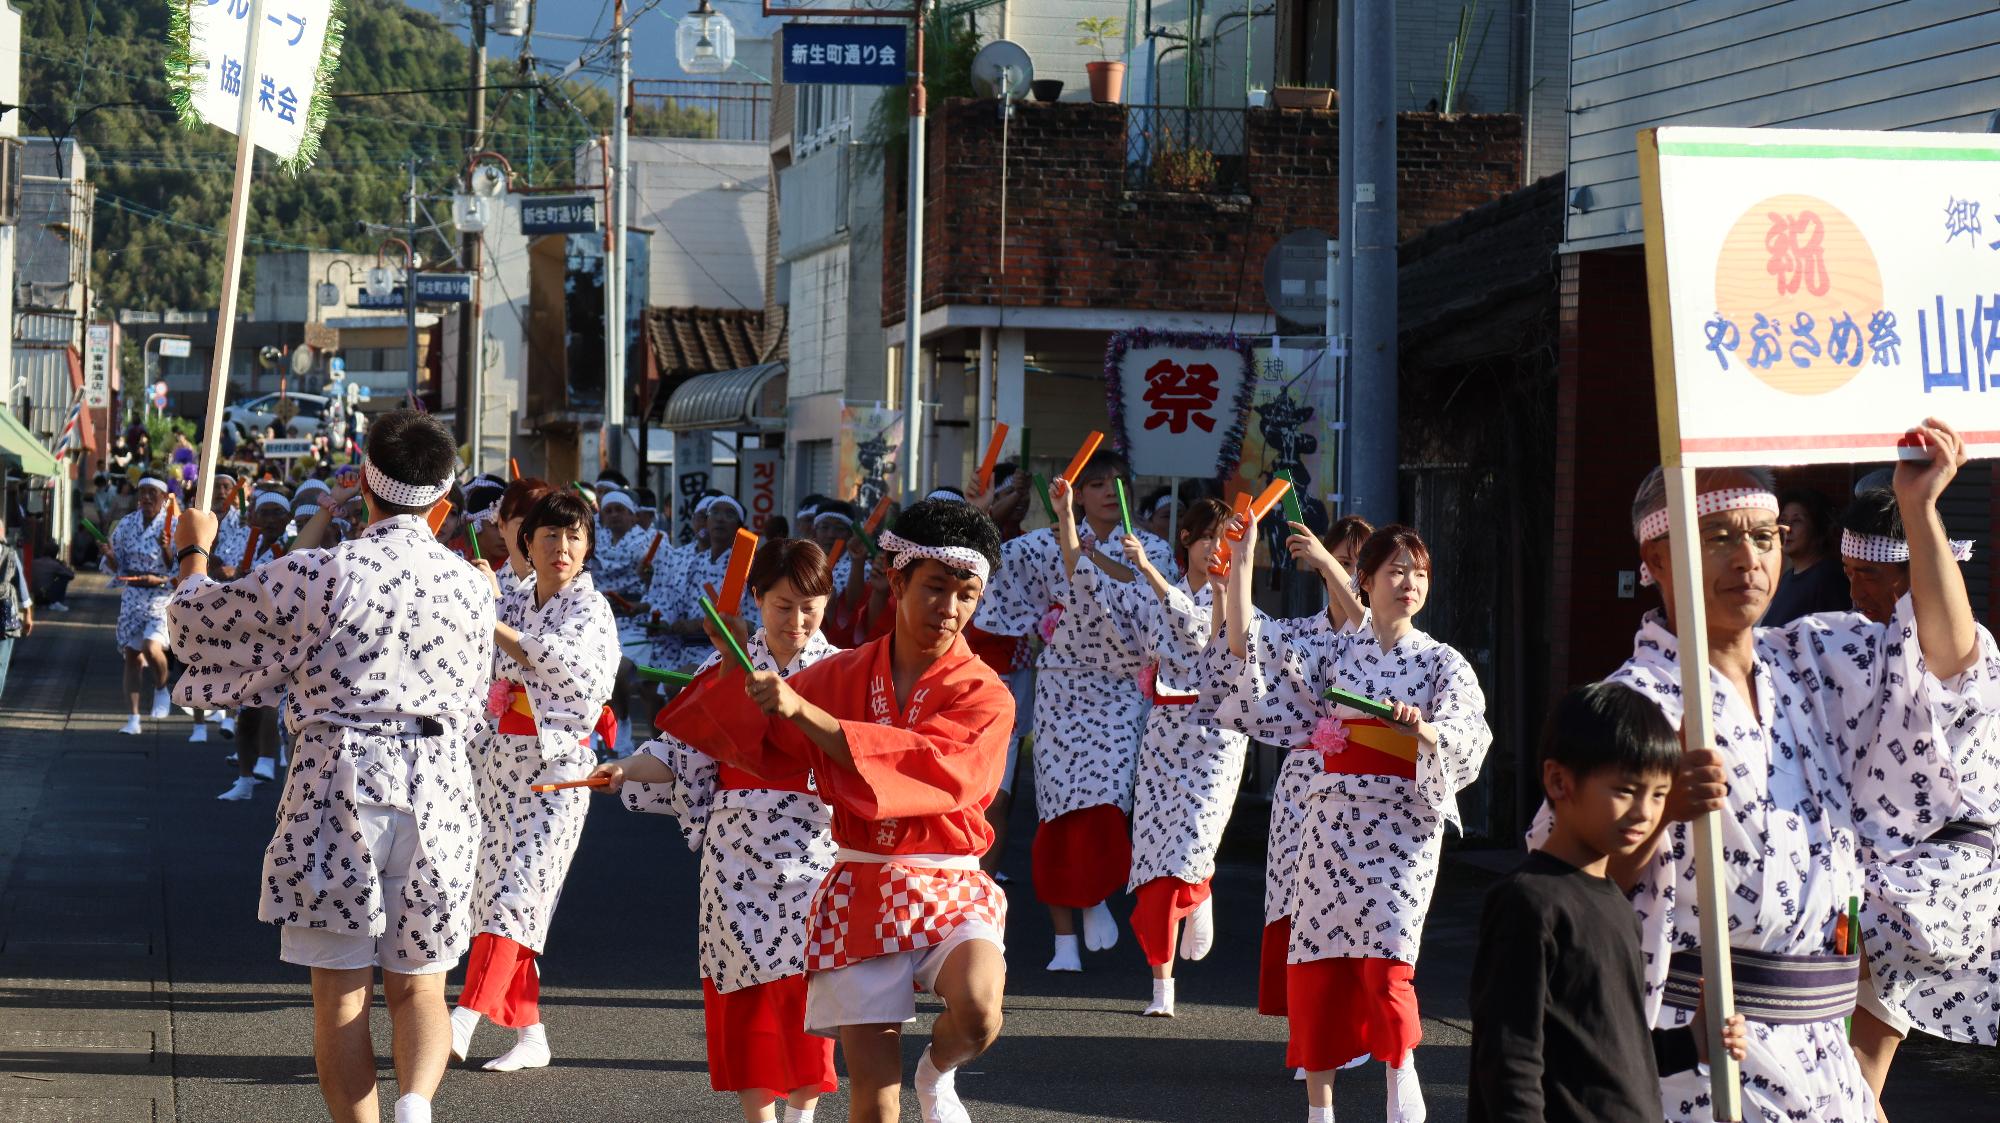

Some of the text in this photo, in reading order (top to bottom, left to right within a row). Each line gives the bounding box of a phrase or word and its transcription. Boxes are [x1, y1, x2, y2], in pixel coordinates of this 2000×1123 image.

[206, 0, 306, 46] ループ
[791, 43, 896, 65] 新生町通り会
[523, 205, 594, 224] 新生町通り会
[1765, 210, 1830, 297] 祝
[1703, 310, 1902, 370] やぶさめ祭
[1142, 359, 1219, 434] 祭
